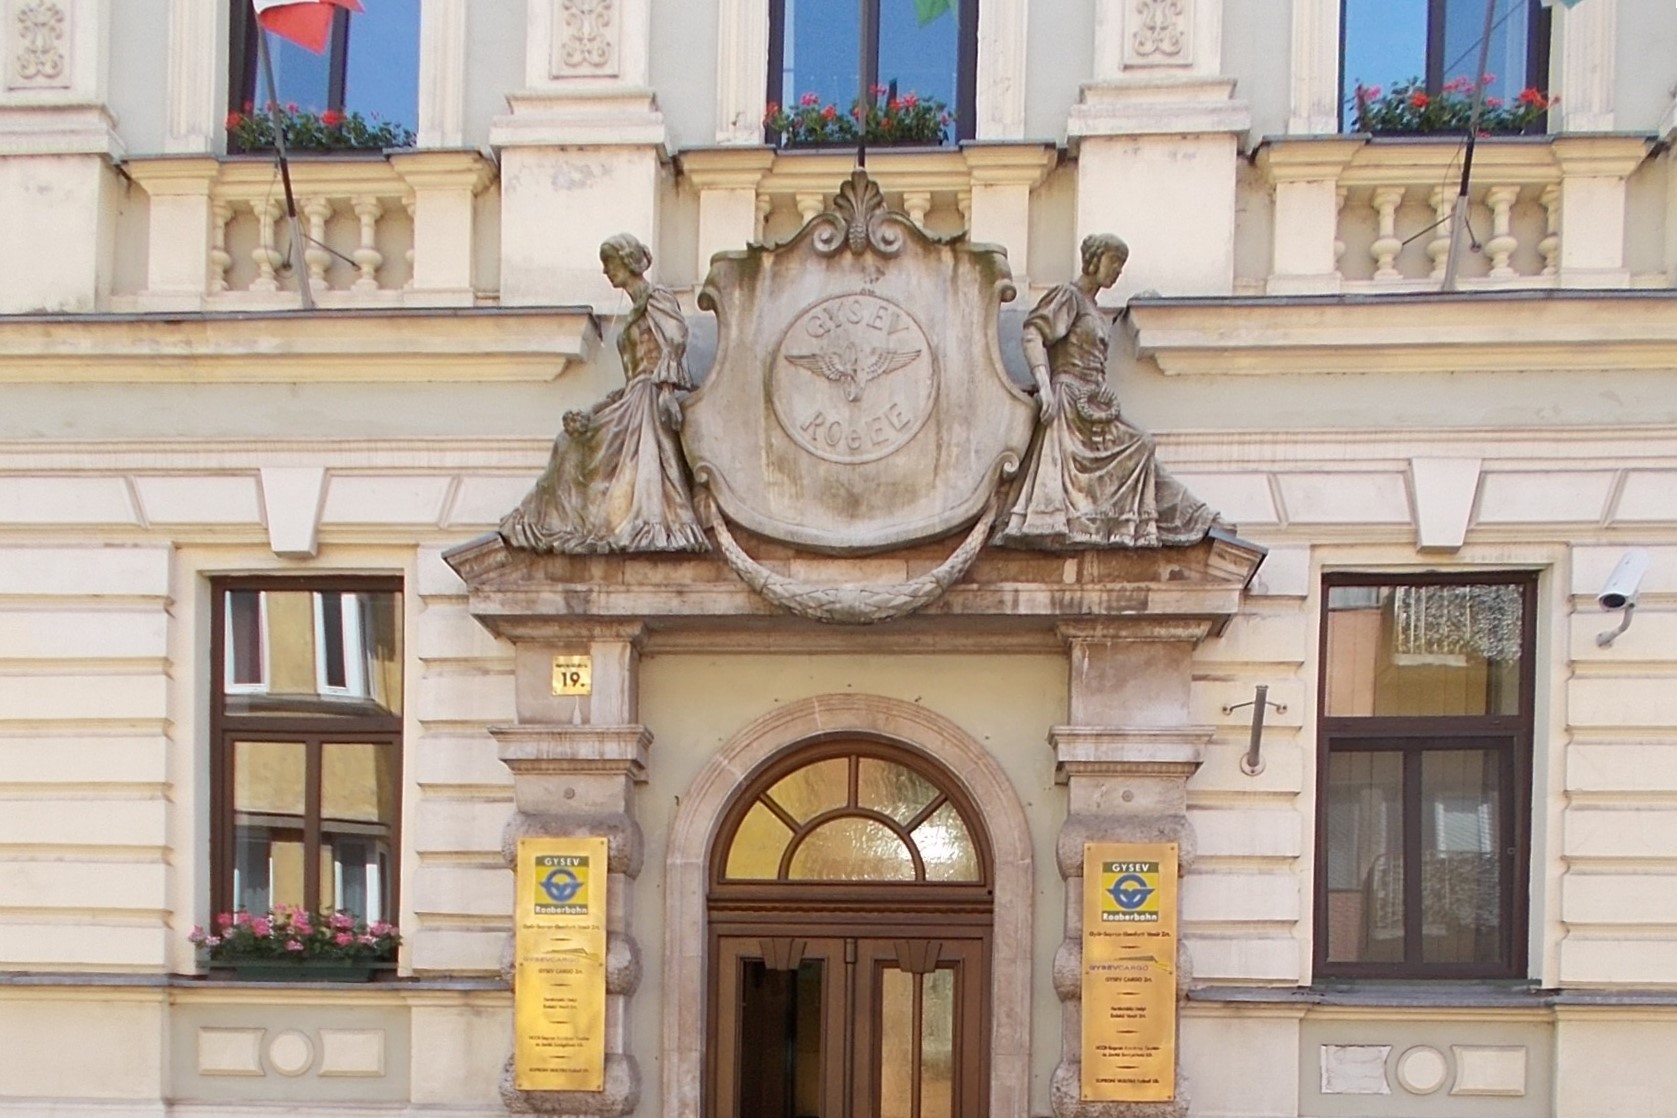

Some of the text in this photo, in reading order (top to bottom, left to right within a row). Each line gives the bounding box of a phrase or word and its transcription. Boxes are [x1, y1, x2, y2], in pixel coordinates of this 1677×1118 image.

[805, 300, 909, 338] GYSEV
[561, 672, 585, 687] 19.
[544, 857, 580, 866] GYSEV
[1112, 863, 1150, 872] GYSEV
[535, 905, 588, 914] Raaberbahn
[1102, 912, 1158, 921] Raaberbahn
